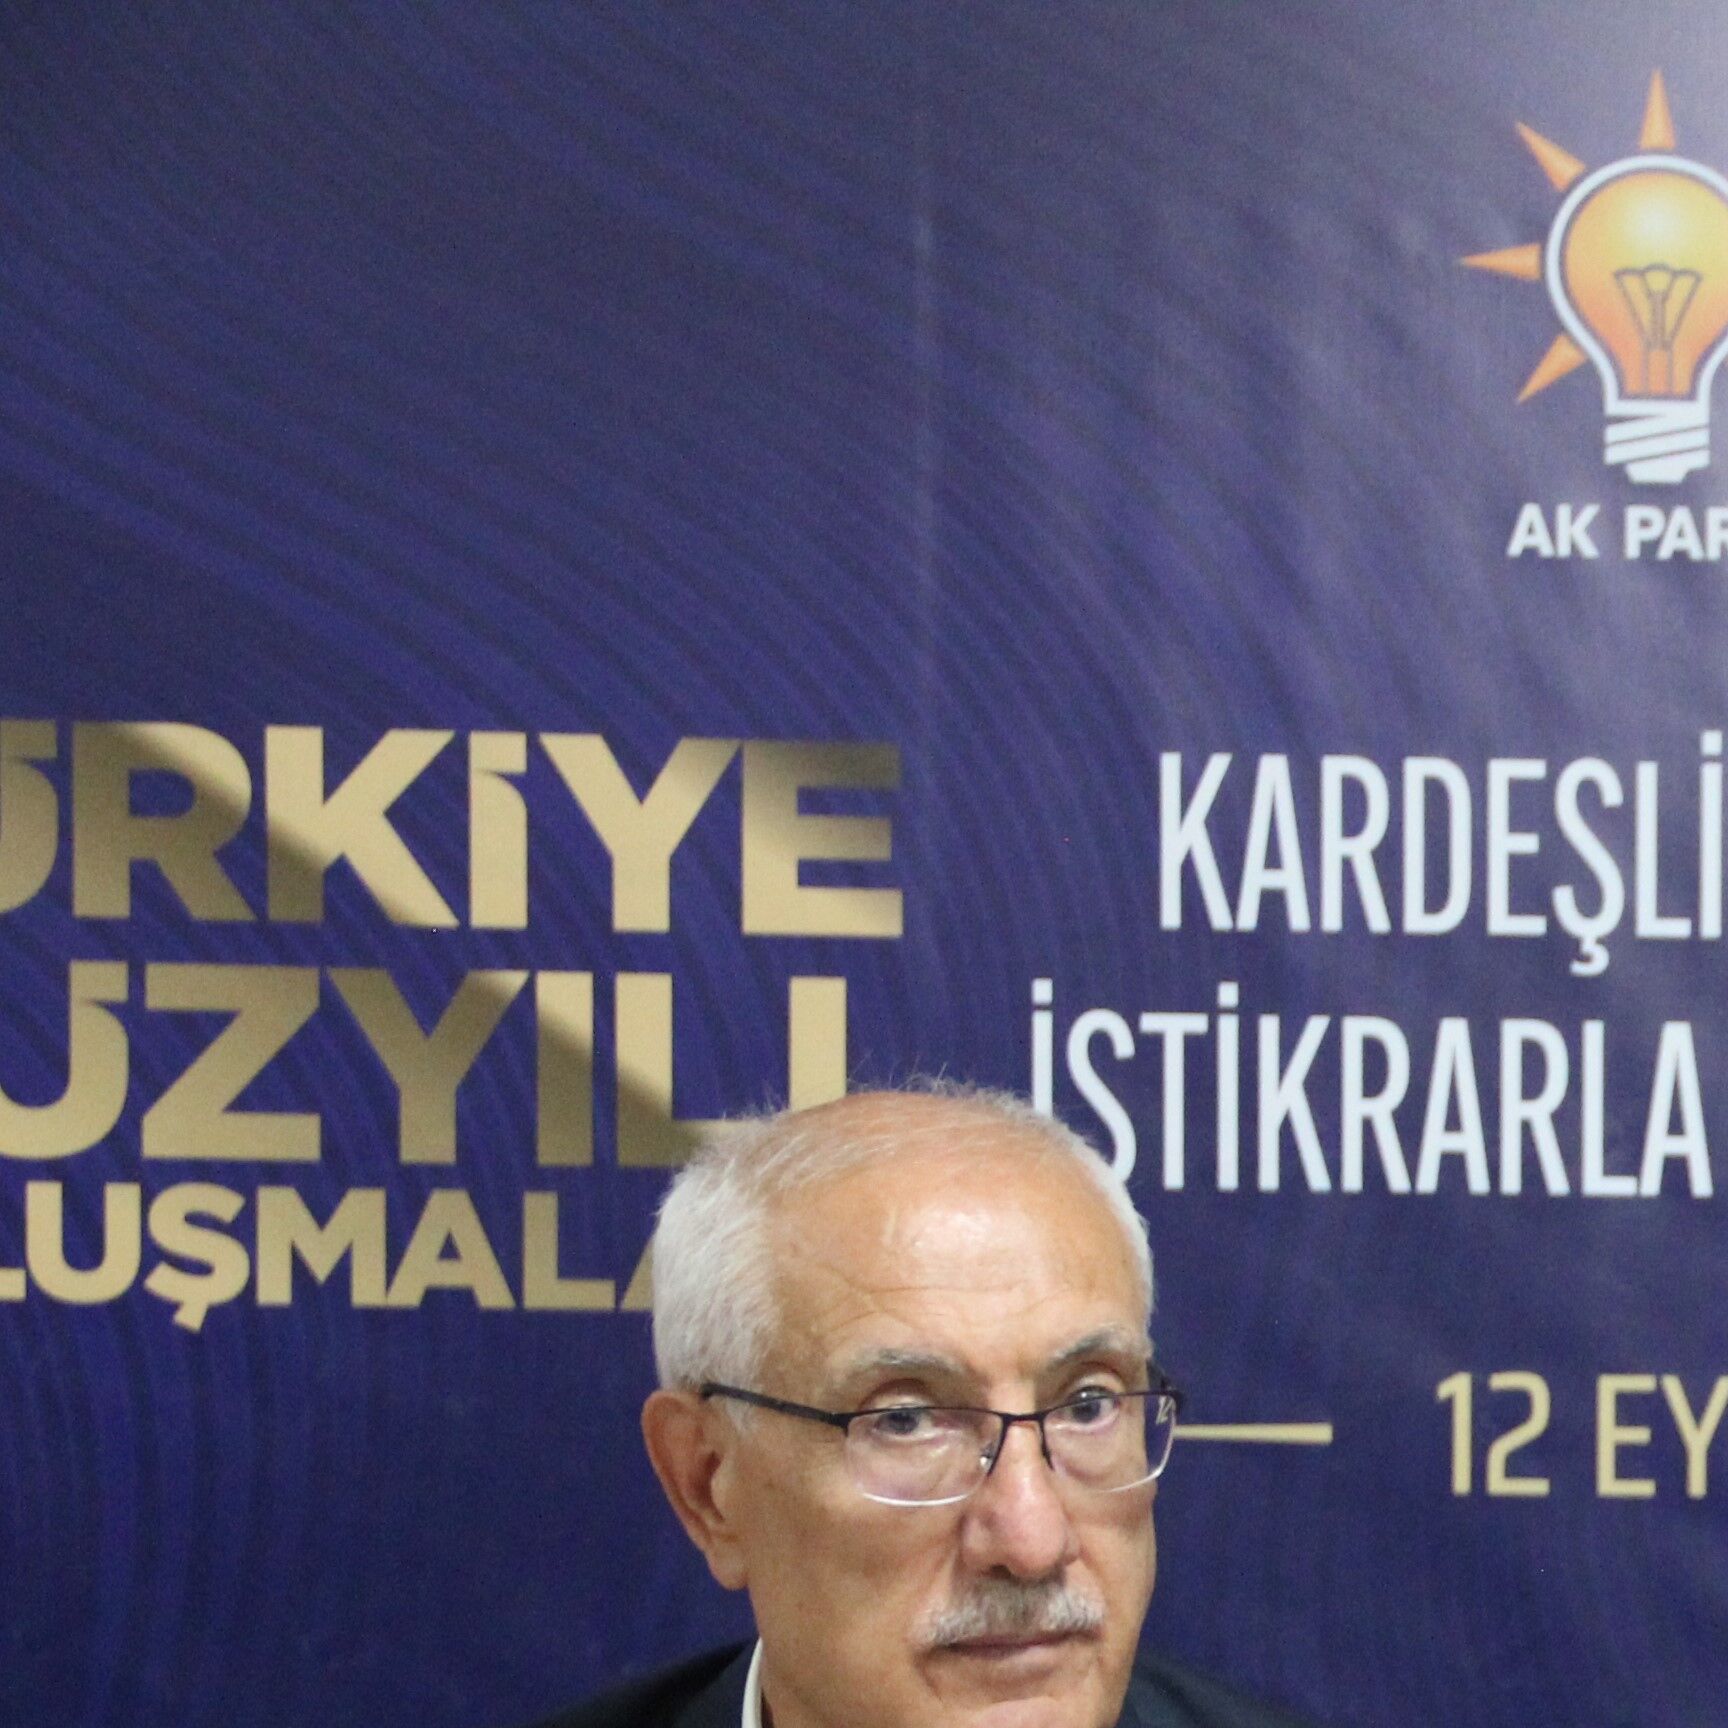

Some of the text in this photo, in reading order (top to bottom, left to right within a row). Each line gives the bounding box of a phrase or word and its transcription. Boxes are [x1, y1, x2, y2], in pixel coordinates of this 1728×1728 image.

[1507, 502, 1600, 559] AK
[1030, 978, 1714, 1198] İSTİKRARLA
[0, 1180, 656, 1333] UŞMAL
[1435, 1371, 1552, 1497] 12
